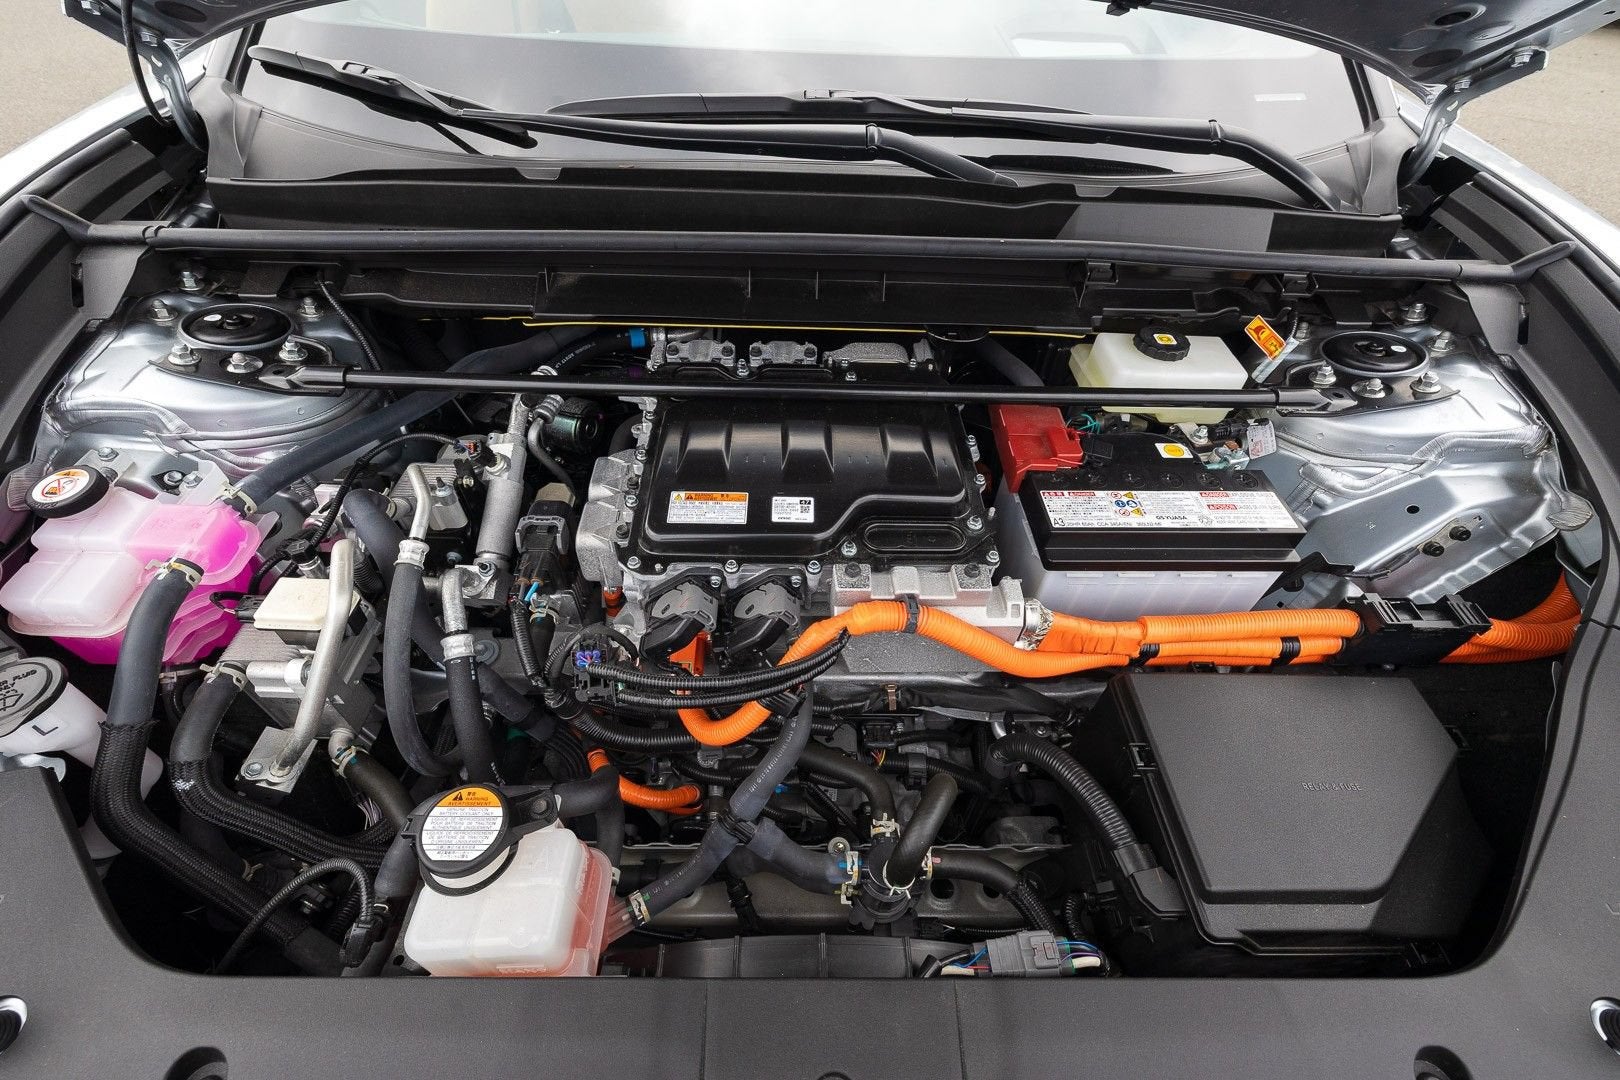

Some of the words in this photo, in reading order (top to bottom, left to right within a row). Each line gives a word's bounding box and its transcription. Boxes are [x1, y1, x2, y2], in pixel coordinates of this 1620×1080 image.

[1053, 517, 1066, 527] A3
[13, 669, 37, 681] FLUID
[1301, 782, 1329, 791] RELAY
[1331, 782, 1339, 791] &
[1340, 782, 1362, 791] FUSE
